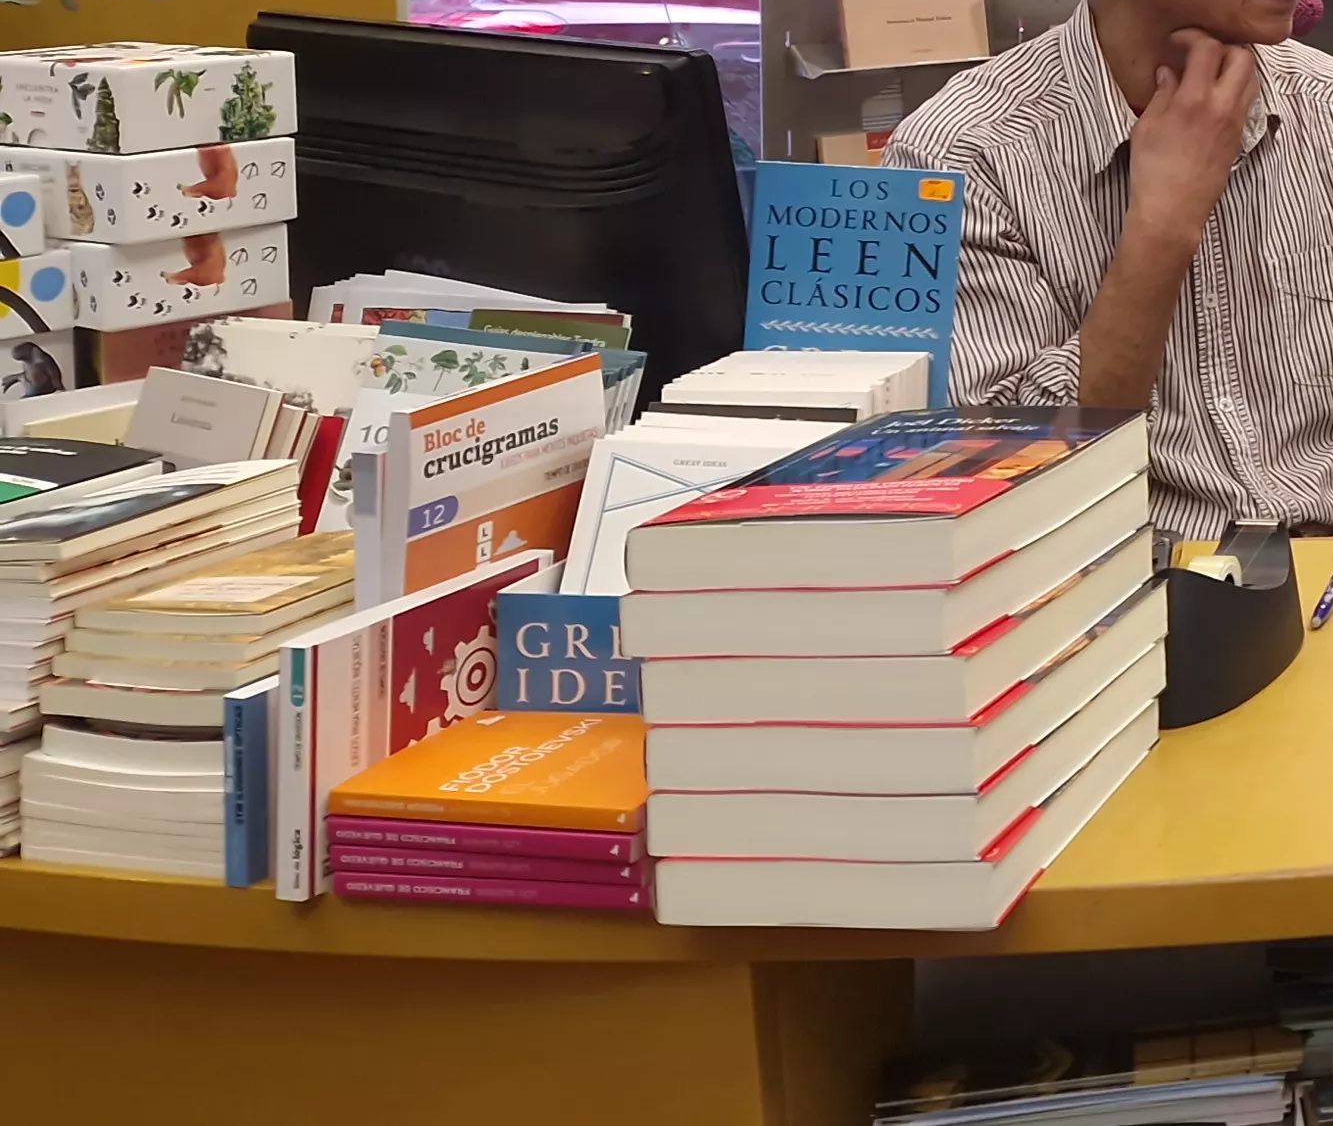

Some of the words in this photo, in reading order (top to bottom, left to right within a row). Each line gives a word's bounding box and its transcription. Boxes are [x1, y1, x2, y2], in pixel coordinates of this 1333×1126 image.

[831, 179, 889, 201] LOS
[767, 204, 948, 236] MODERNOS
[765, 235, 943, 280] LEEN
[761, 278, 941, 314] CLÁSICOS
[424, 428, 462, 453] Bloc
[466, 418, 486, 440] de
[903, 425, 974, 434] animal
[976, 424, 1042, 433] salvaje
[938, 416, 1021, 425] Dicker
[424, 418, 559, 479] crucigramas
[422, 504, 445, 528] 12
[465, 719, 604, 794] DOSTOIEVSKI
[292, 829, 303, 859] lógica
